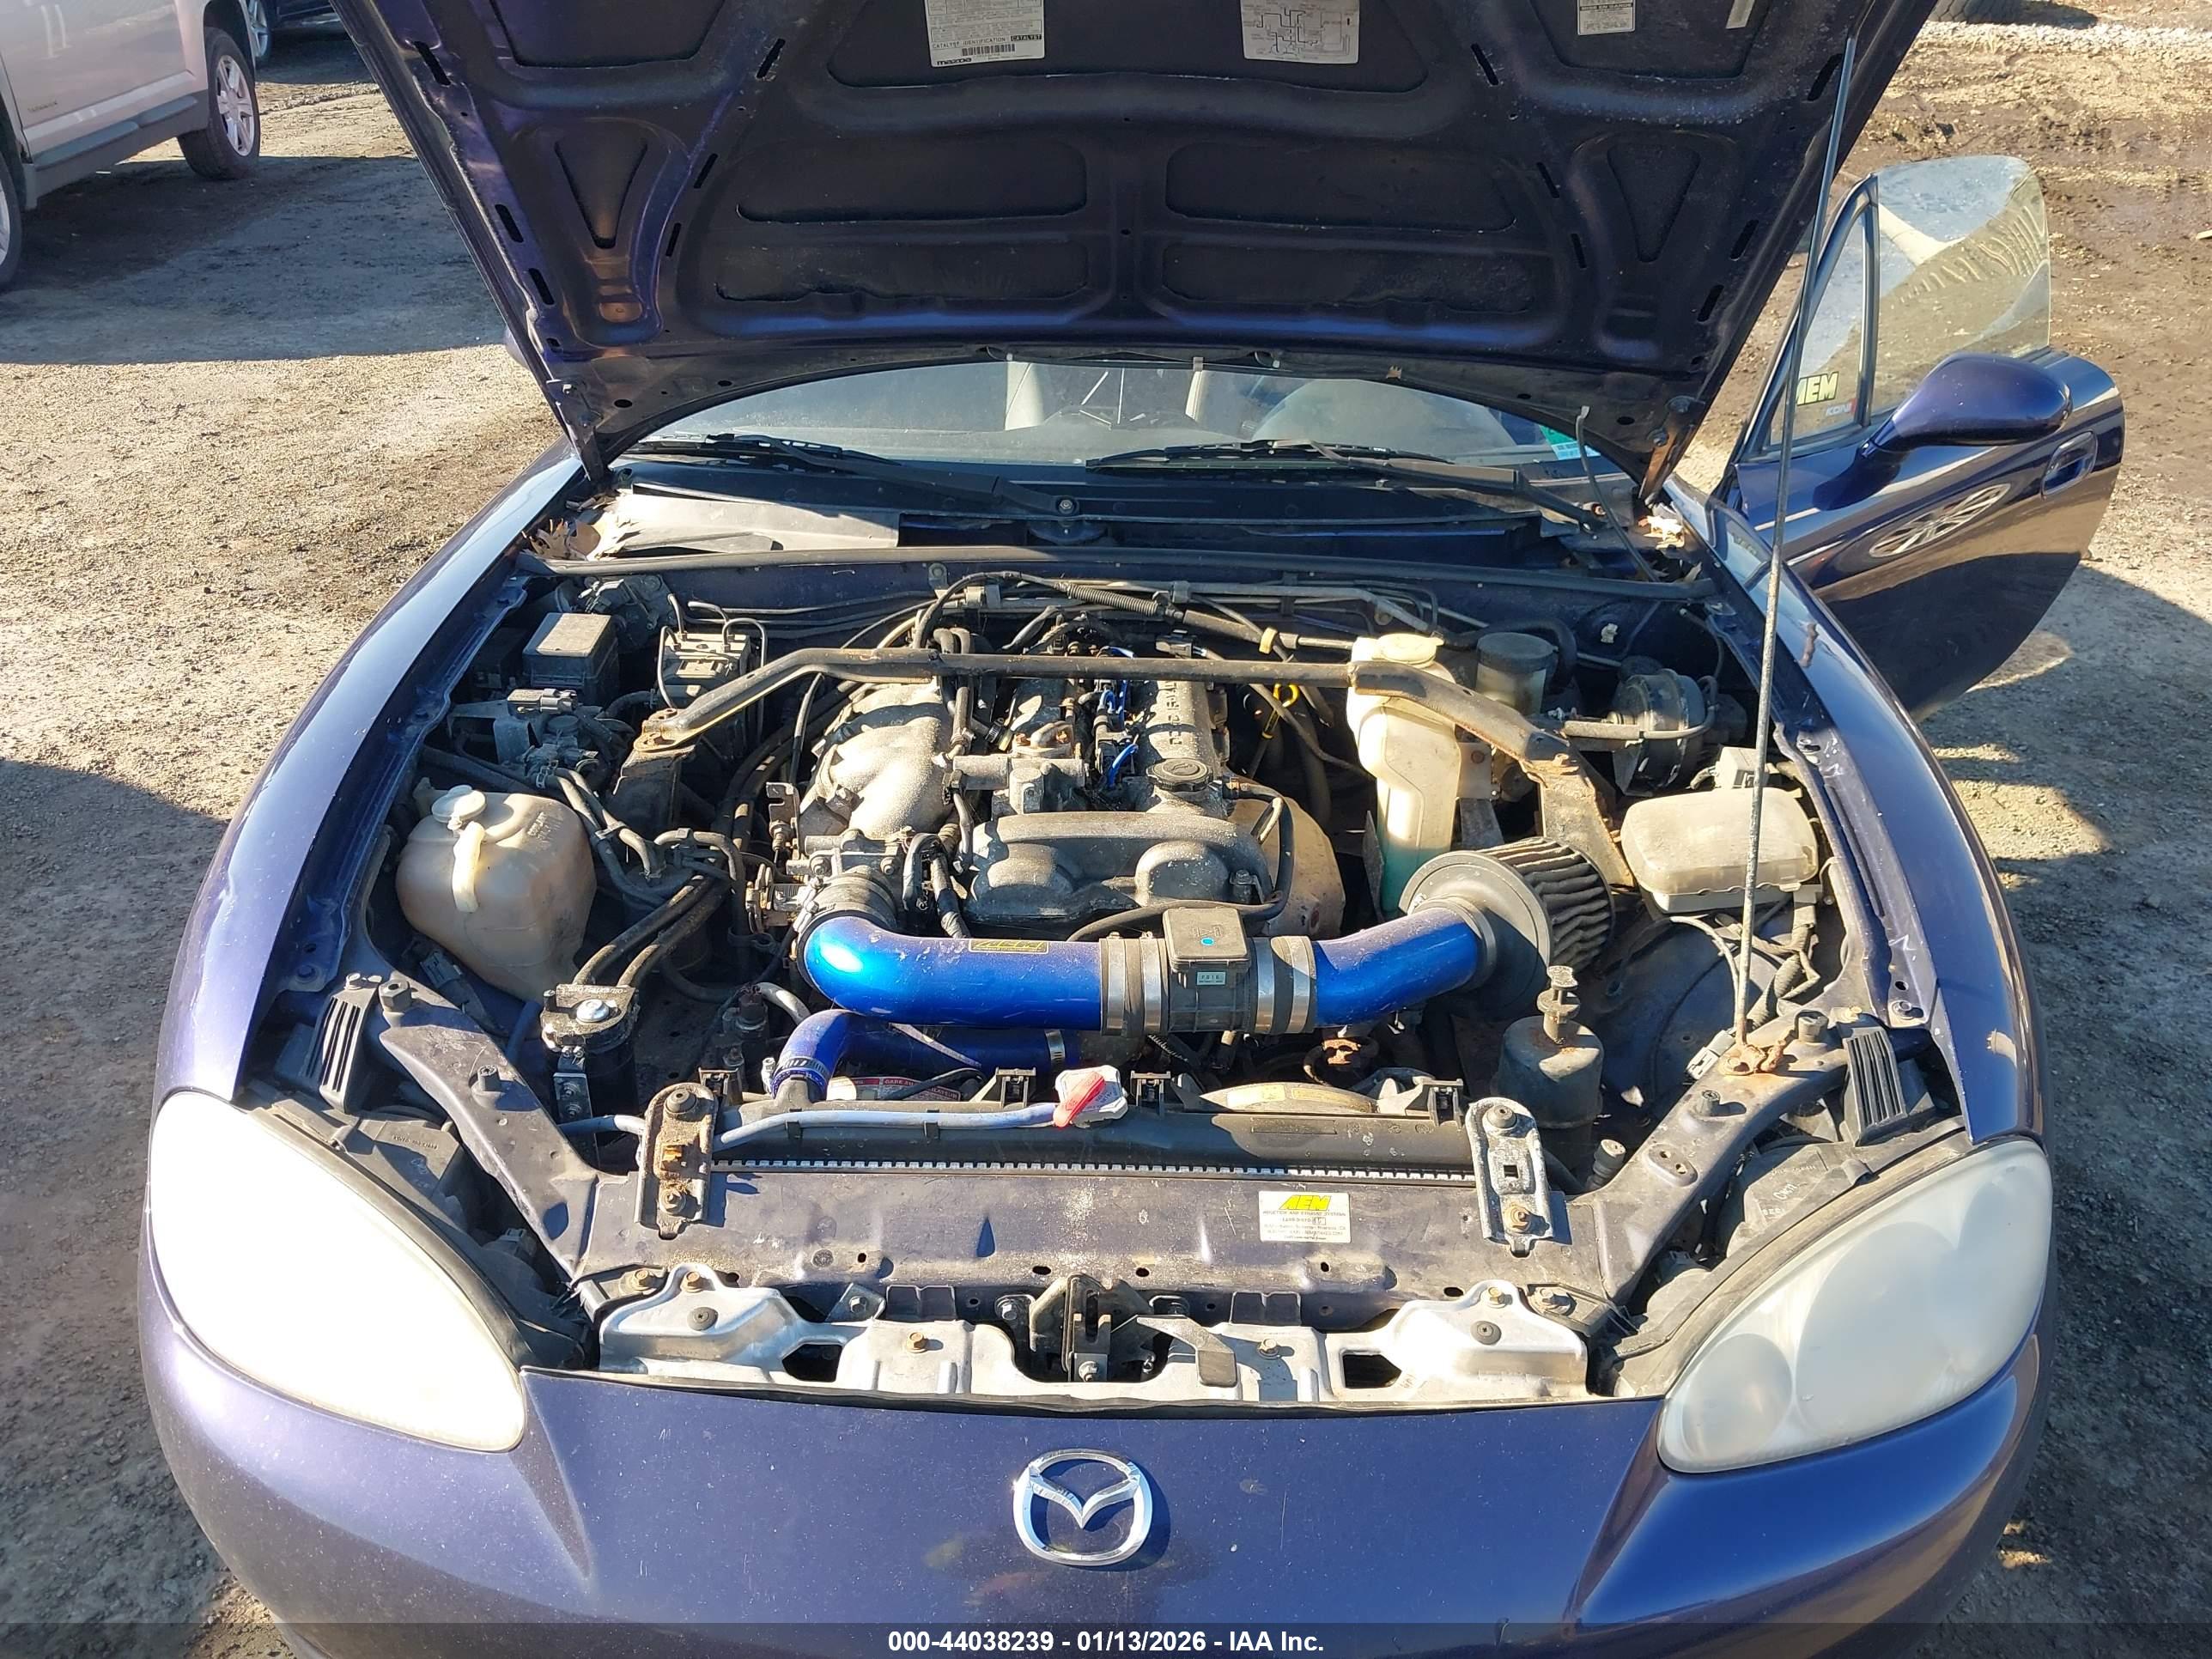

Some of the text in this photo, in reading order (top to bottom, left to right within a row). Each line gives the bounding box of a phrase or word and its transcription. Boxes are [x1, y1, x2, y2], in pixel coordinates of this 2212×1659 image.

[932, 37, 1006, 49] CATALYST IDENTIFICATION
[1279, 1194, 1332, 1211] AEM
